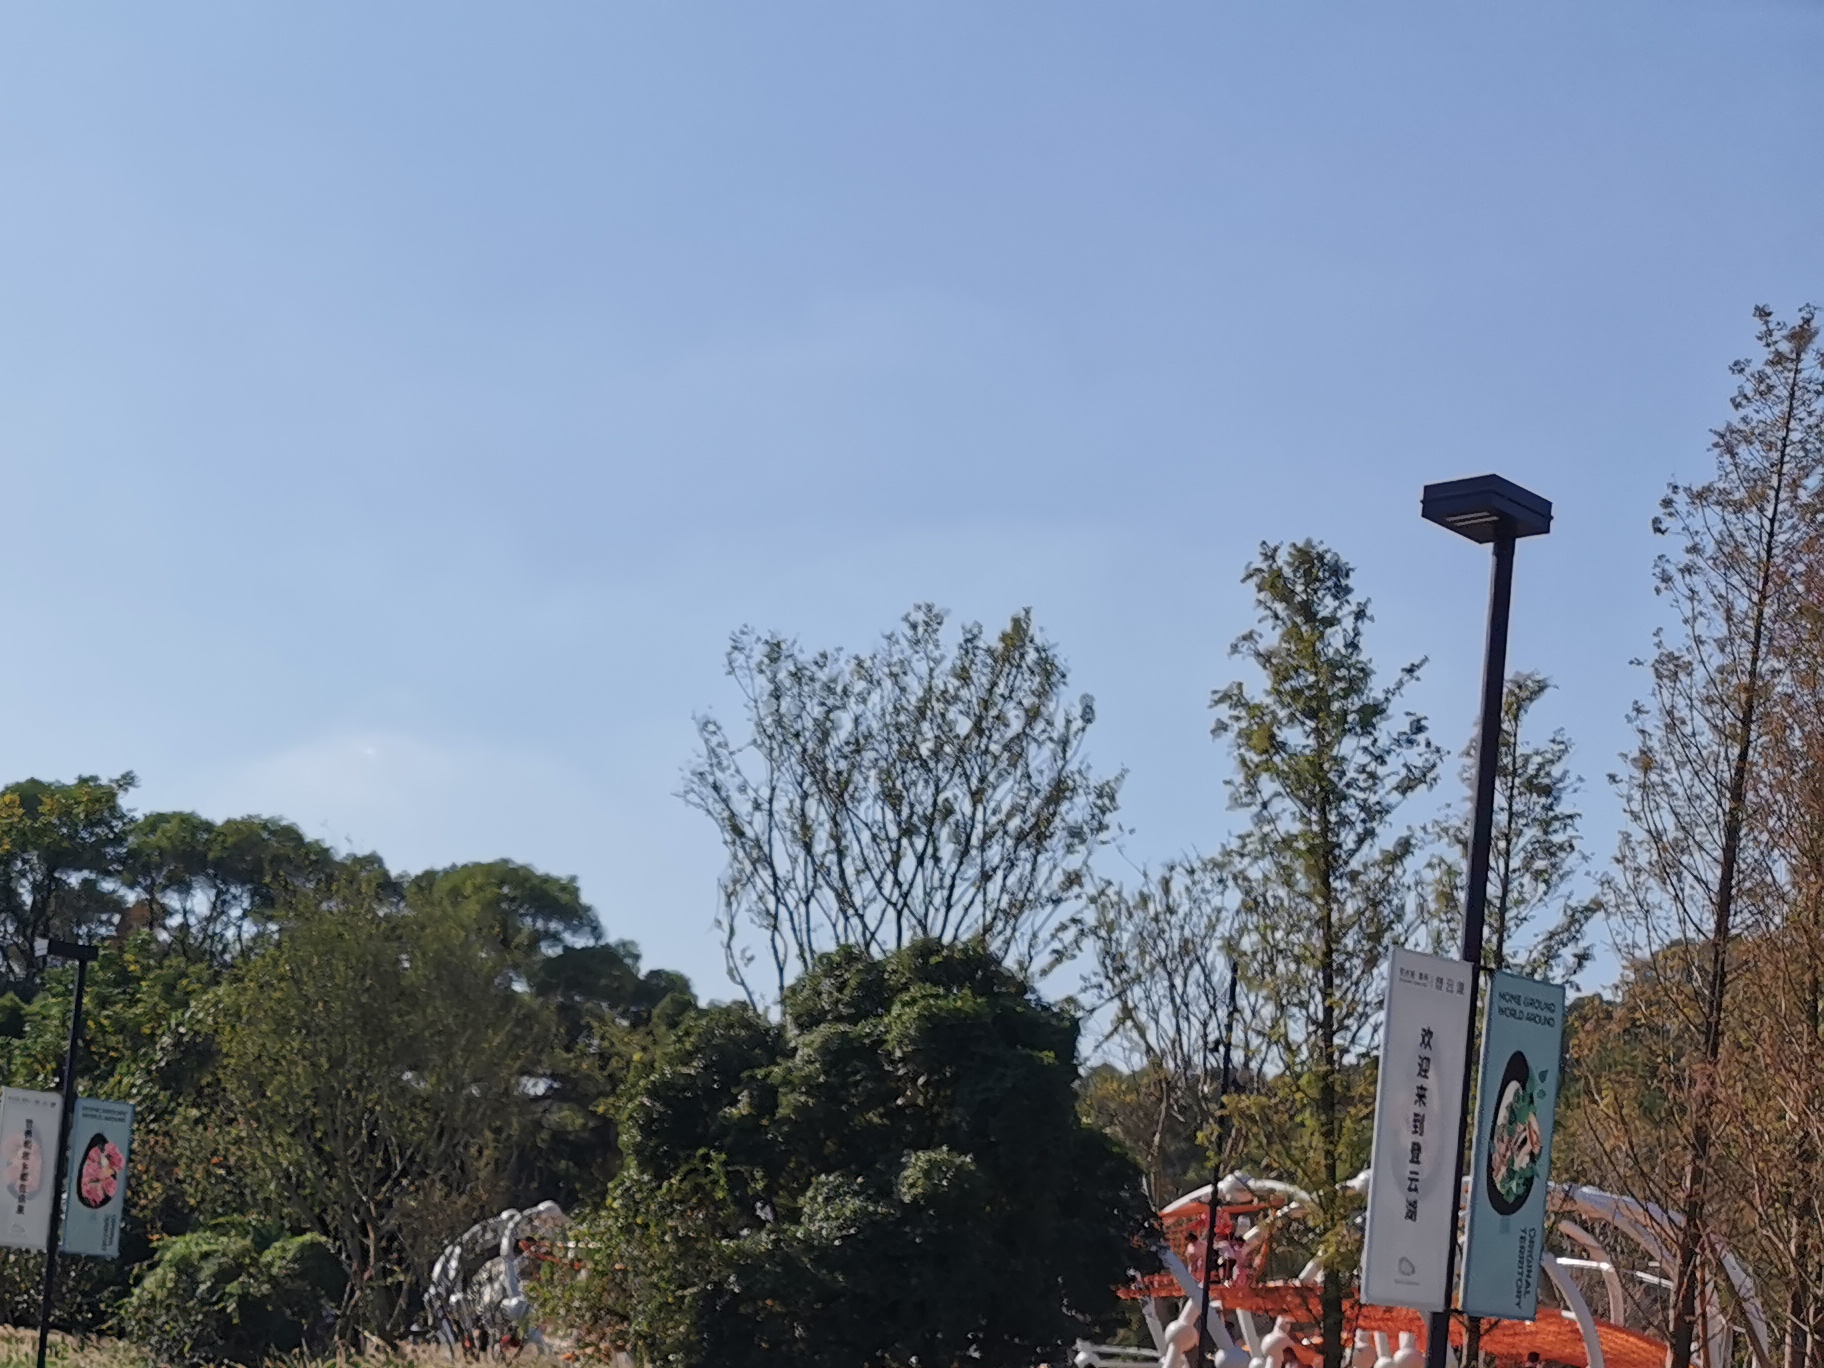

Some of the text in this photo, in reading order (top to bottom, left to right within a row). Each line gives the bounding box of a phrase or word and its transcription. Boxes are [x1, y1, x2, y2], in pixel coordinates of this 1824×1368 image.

[1404, 1026, 1434, 1223] 欢迎来到登云湖
